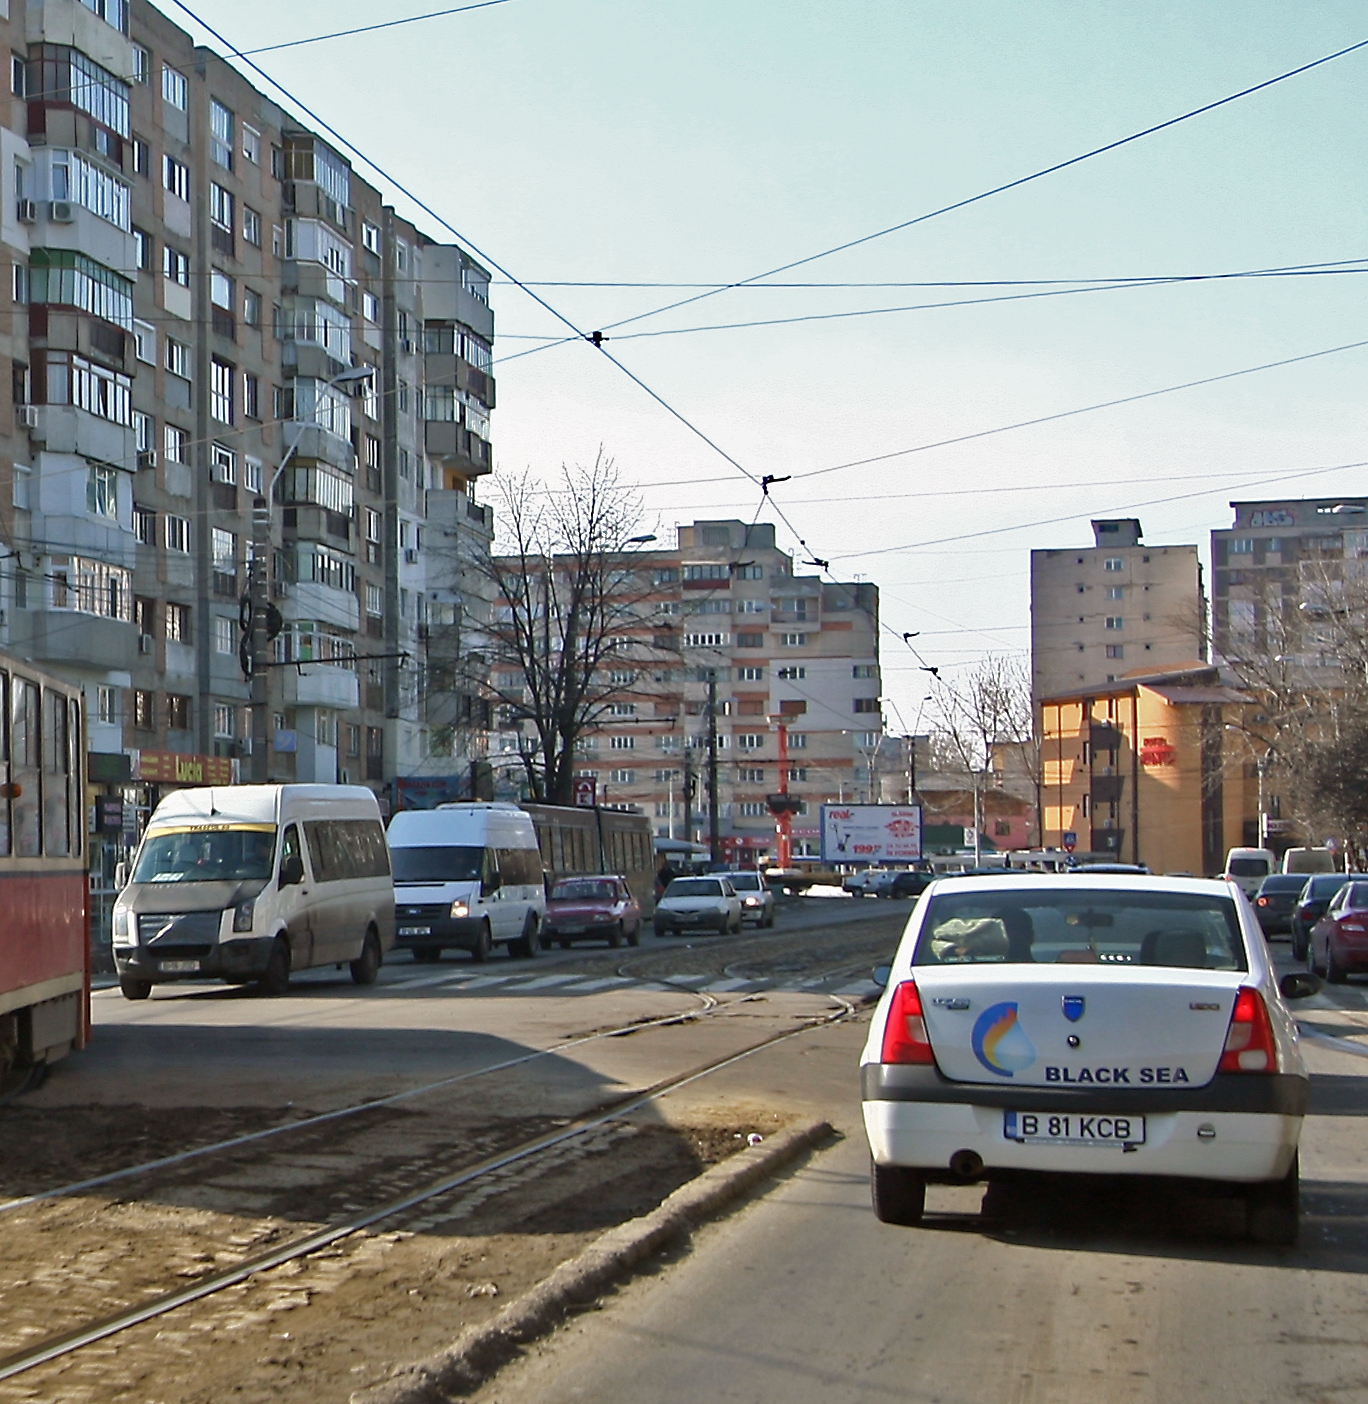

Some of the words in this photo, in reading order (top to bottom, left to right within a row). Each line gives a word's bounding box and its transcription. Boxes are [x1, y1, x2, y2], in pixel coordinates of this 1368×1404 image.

[175, 755, 203, 782] Lucia
[1045, 1066, 1130, 1083] BLACK
[1139, 1067, 1190, 1083] SEA
[1022, 1115, 1038, 1136] B
[1048, 1116, 1070, 1137] 81
[1080, 1117, 1131, 1139] KCB
